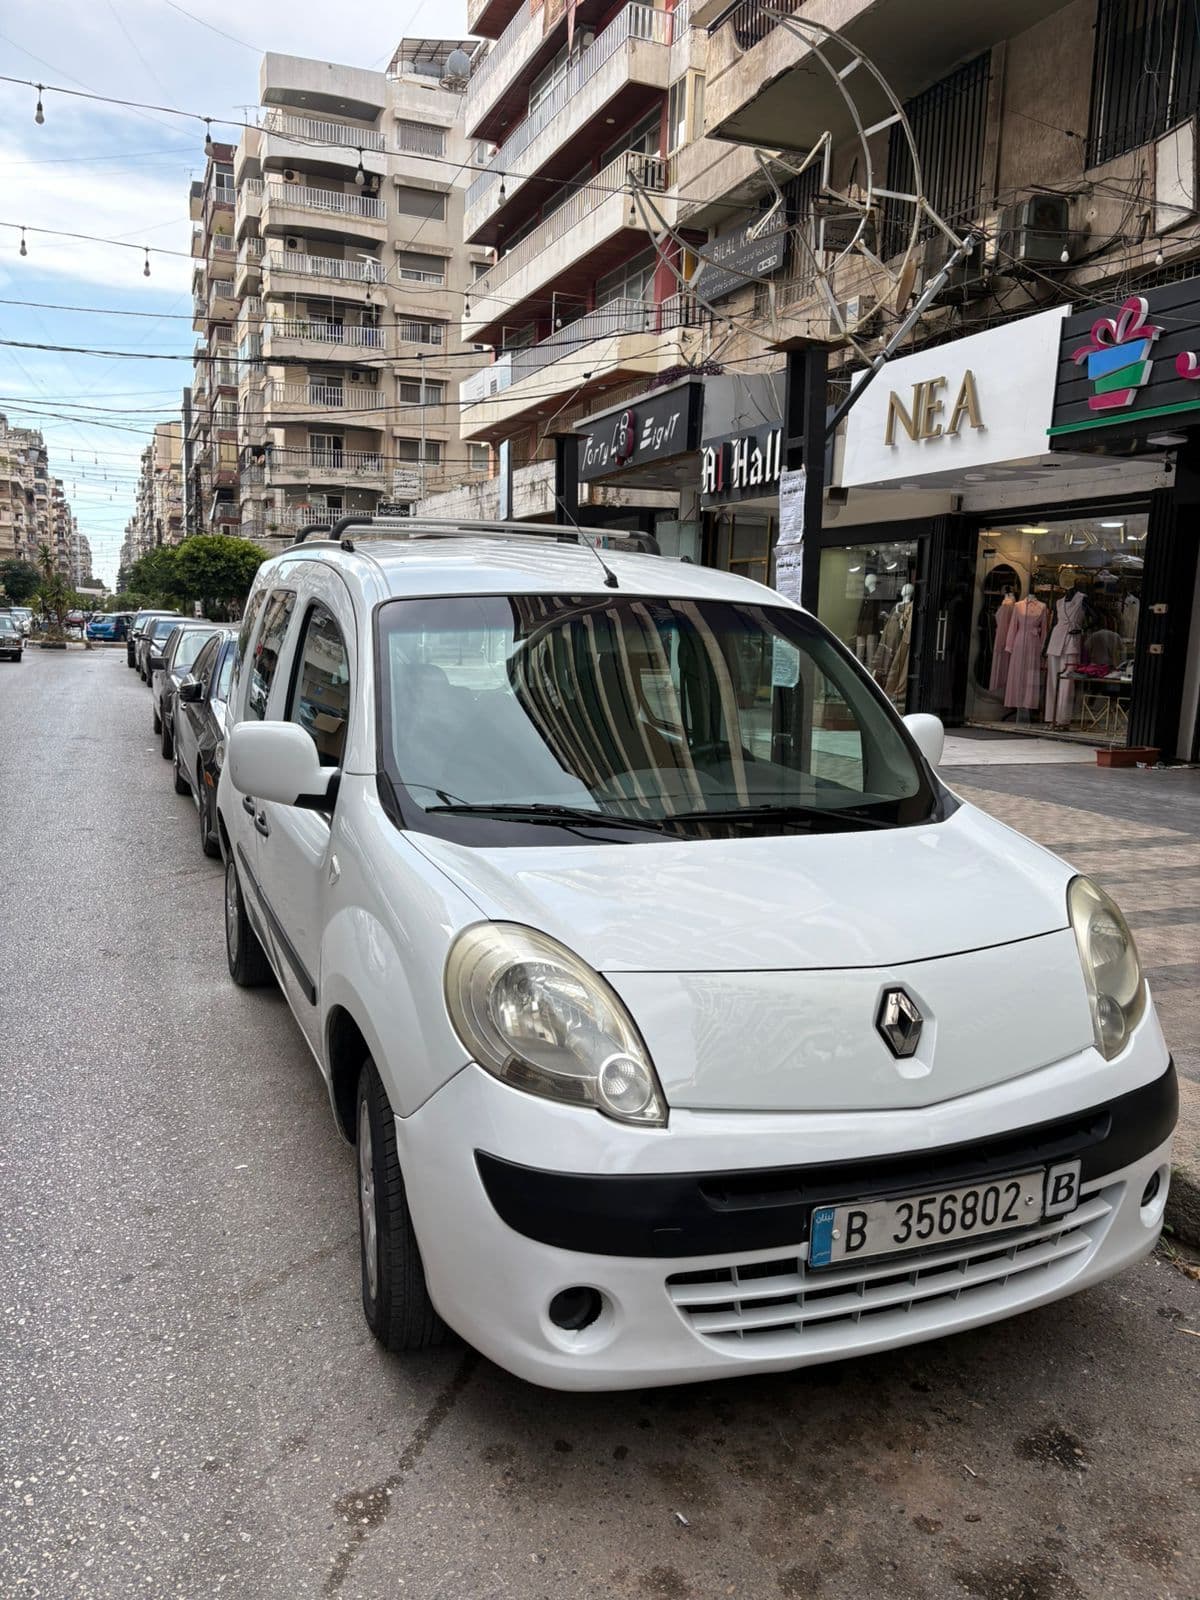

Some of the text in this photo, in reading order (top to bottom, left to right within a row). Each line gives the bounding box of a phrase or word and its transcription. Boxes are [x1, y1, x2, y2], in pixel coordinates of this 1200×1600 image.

[884, 369, 988, 446] NEA
[731, 428, 782, 489] Hall
[845, 1181, 1021, 1253] B 356802
[1049, 1172, 1076, 1207] B
